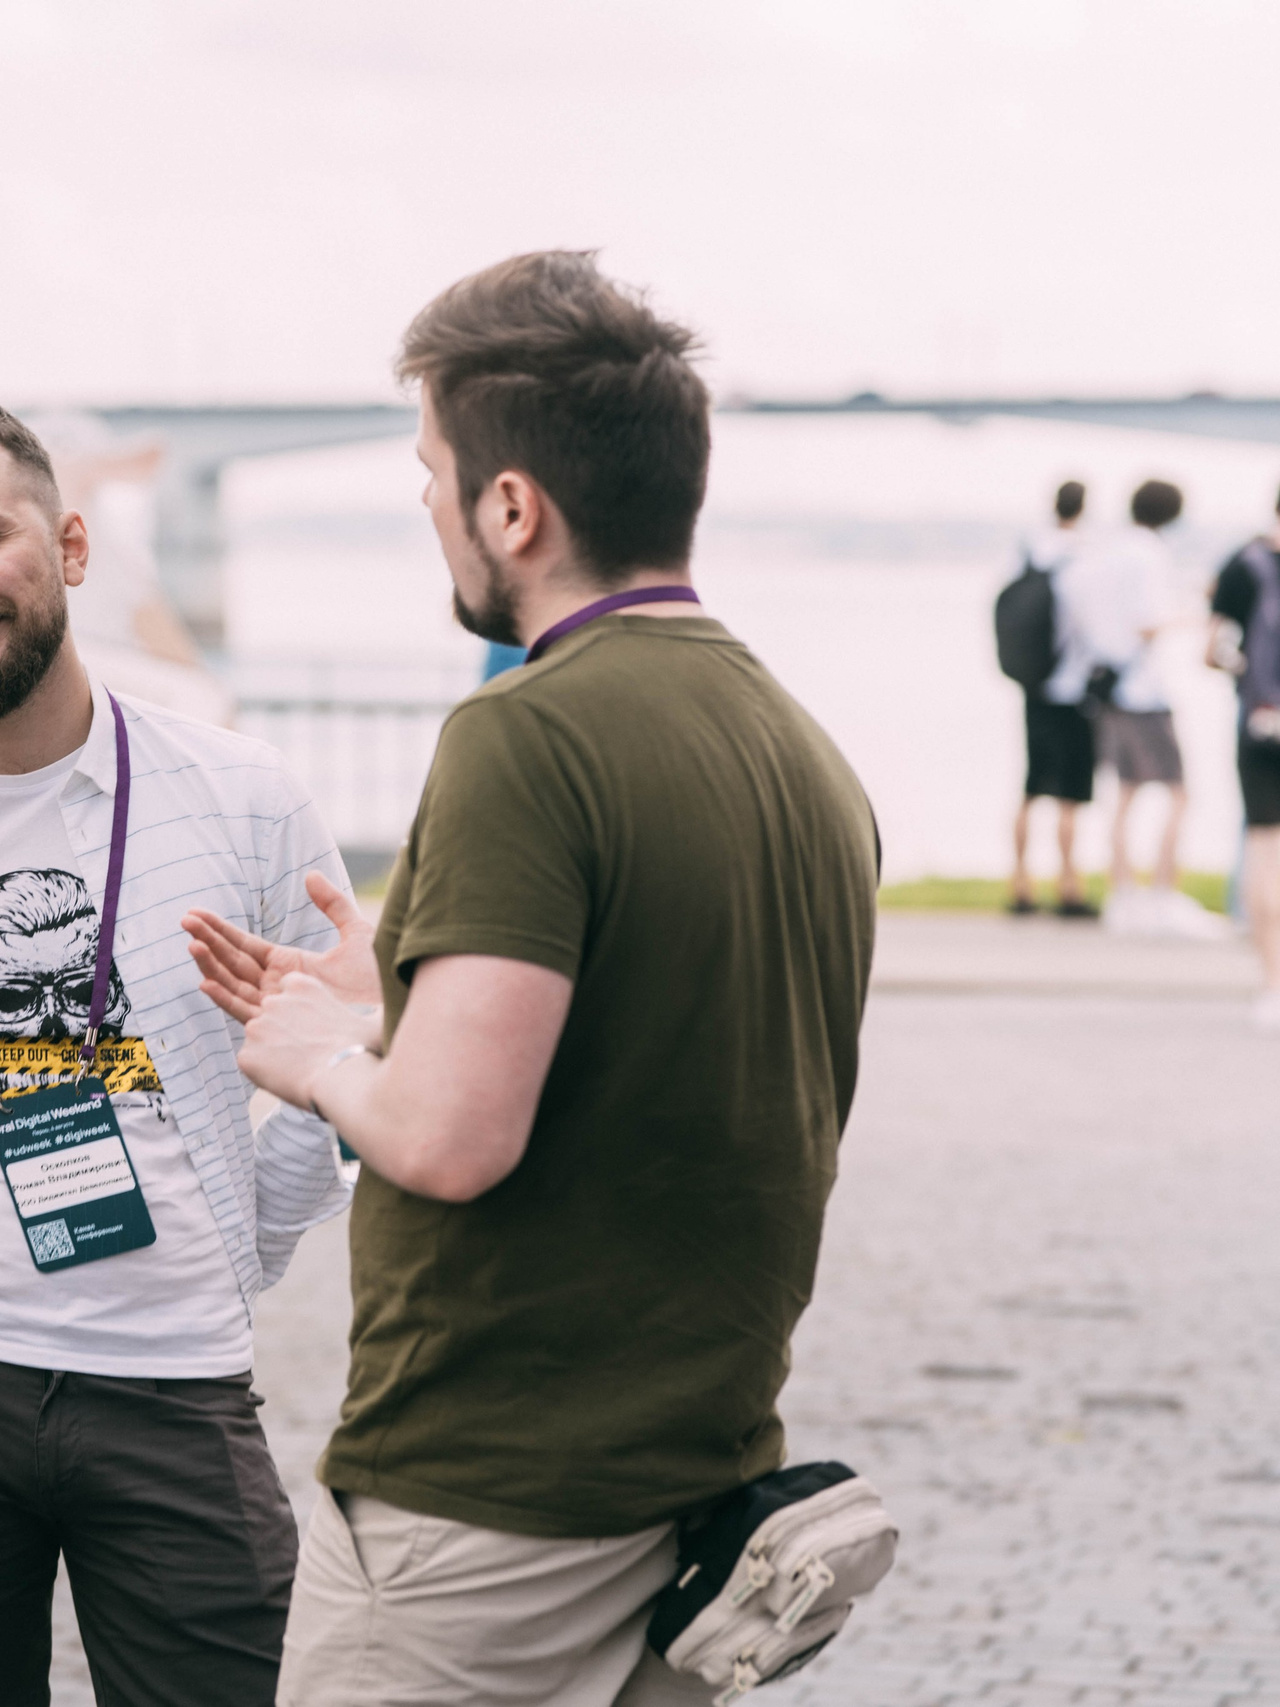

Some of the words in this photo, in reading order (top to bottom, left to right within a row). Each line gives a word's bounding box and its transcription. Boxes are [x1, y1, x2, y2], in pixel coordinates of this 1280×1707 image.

[28, 1048, 50, 1062] OUT
[15, 1110, 51, 1130] Digital
[50, 1098, 102, 1120] Weekend
[4, 1138, 52, 1159] #udweek
[55, 1122, 111, 1146] #digiweek
